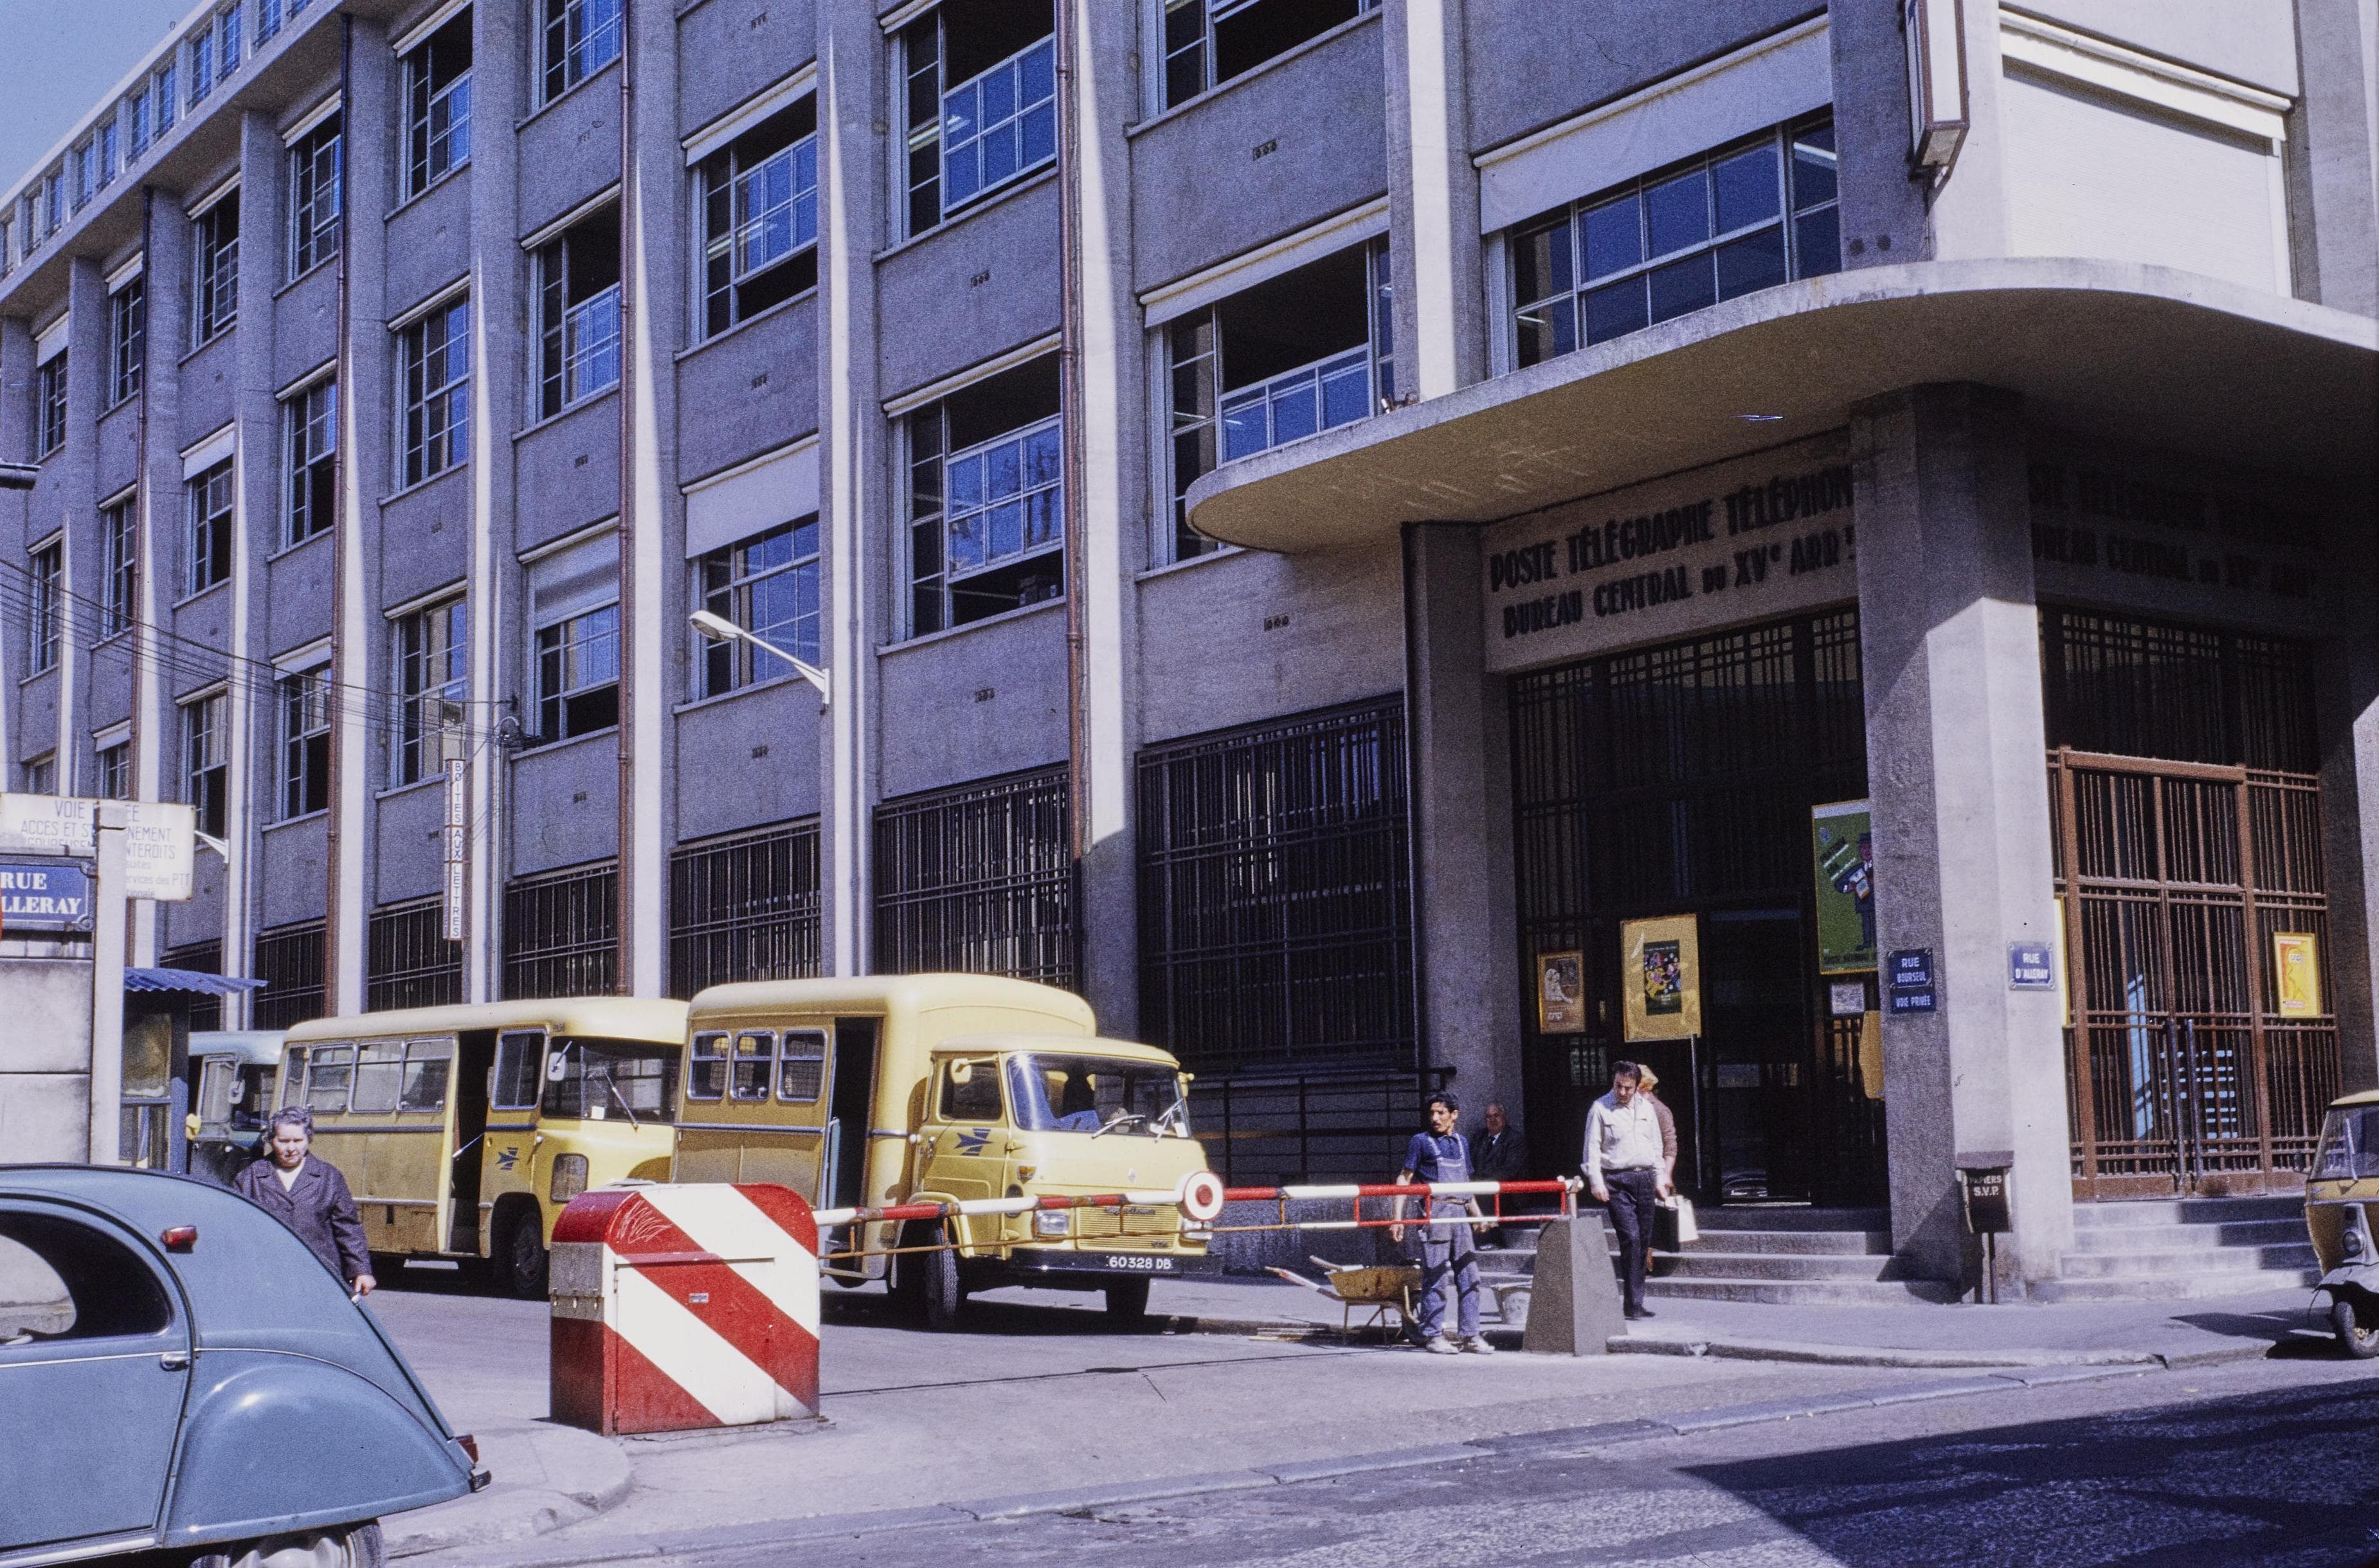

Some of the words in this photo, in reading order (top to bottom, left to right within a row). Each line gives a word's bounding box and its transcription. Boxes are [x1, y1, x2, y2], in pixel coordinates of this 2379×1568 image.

[1490, 541, 1557, 592] POSTE
[1566, 499, 1716, 574] TÉLÉGRAPHE
[1723, 464, 1854, 536] TÉLÉPHON
[1503, 590, 1583, 638] BUREAU
[1593, 565, 1693, 617] CENTRAL
[1702, 565, 1726, 594] DU
[55, 800, 86, 818] VOIE
[64, 822, 77, 837] ET
[0, 872, 47, 890] RUE
[124, 875, 153, 884] ervices
[1, 896, 82, 914] LLERAY
[1901, 957, 1920, 968] RUE
[2023, 953, 2040, 964] RUE
[1895, 997, 1909, 1007] VOIE
[1974, 1186, 1999, 1196] S.V.P.
[1156, 1258, 1172, 1270] DB
